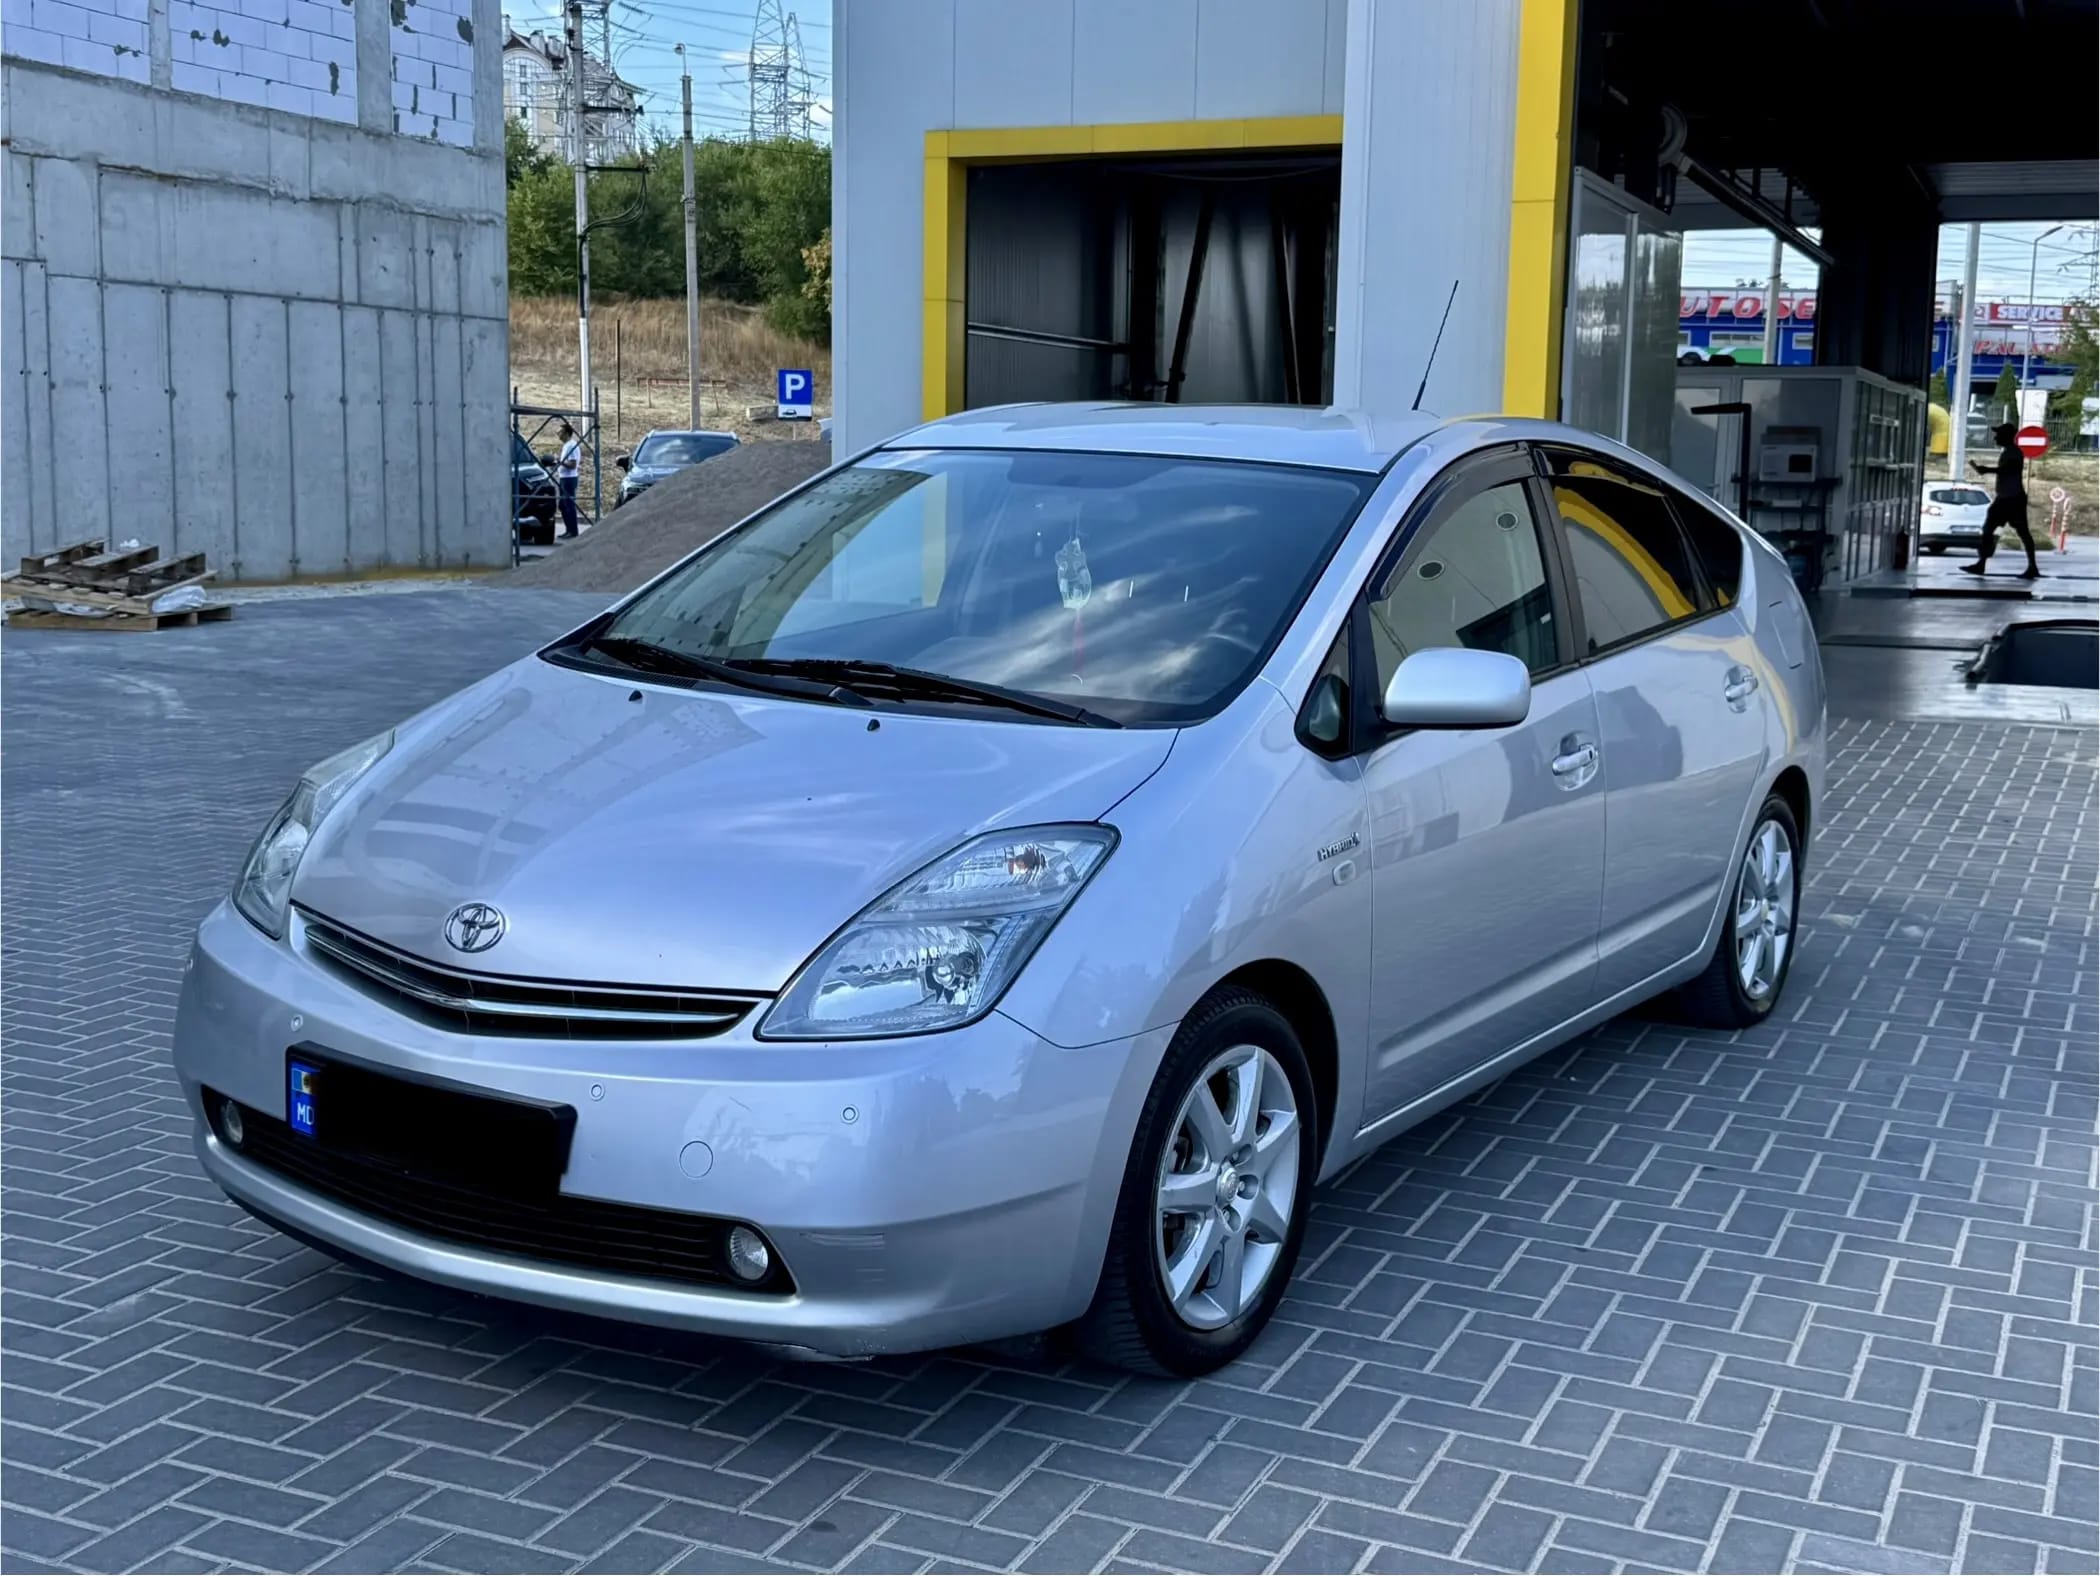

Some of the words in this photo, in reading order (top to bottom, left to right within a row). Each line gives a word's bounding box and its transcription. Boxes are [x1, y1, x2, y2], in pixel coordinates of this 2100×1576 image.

[1998, 305, 2063, 320] SERVICE
[785, 373, 805, 400] P
[297, 1102, 315, 1125] MD
